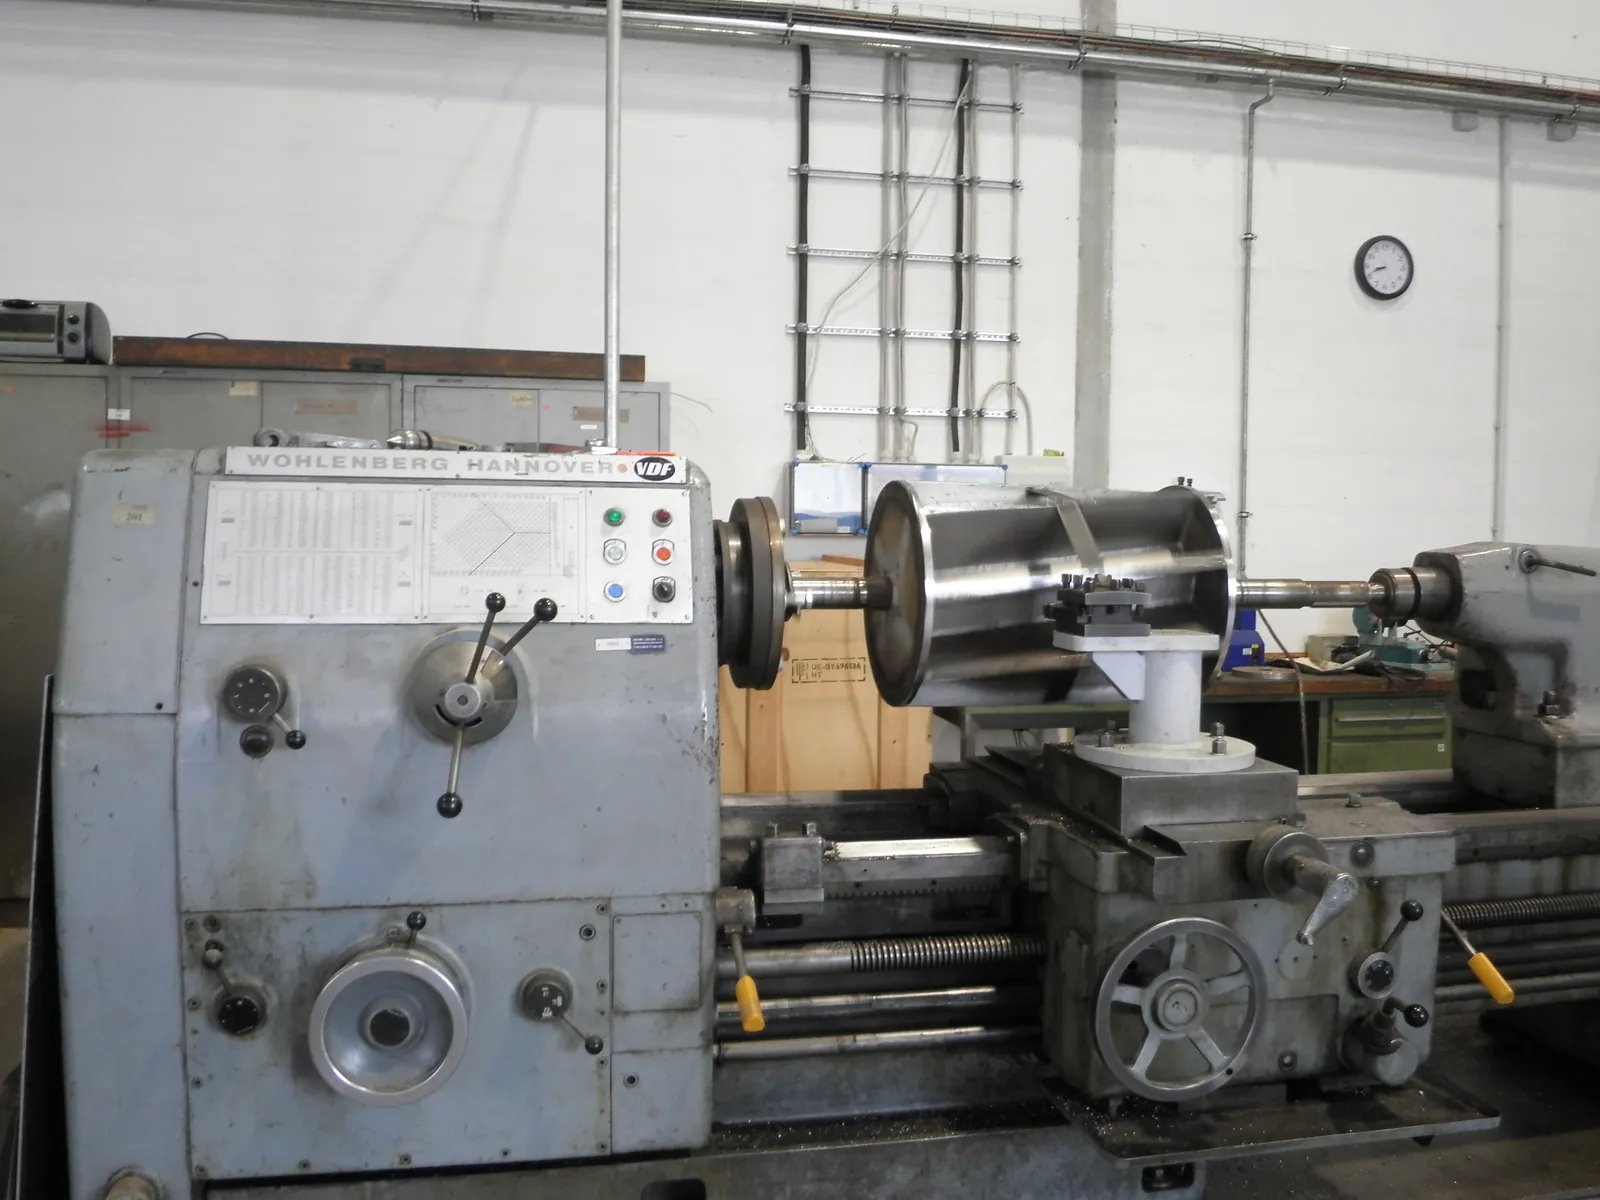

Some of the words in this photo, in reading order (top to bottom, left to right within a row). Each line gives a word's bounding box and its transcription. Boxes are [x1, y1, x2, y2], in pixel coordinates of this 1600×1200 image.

[247, 453, 449, 472] WOHLENBERG
[466, 457, 613, 475] HANNOVER
[636, 461, 673, 477] VDF
